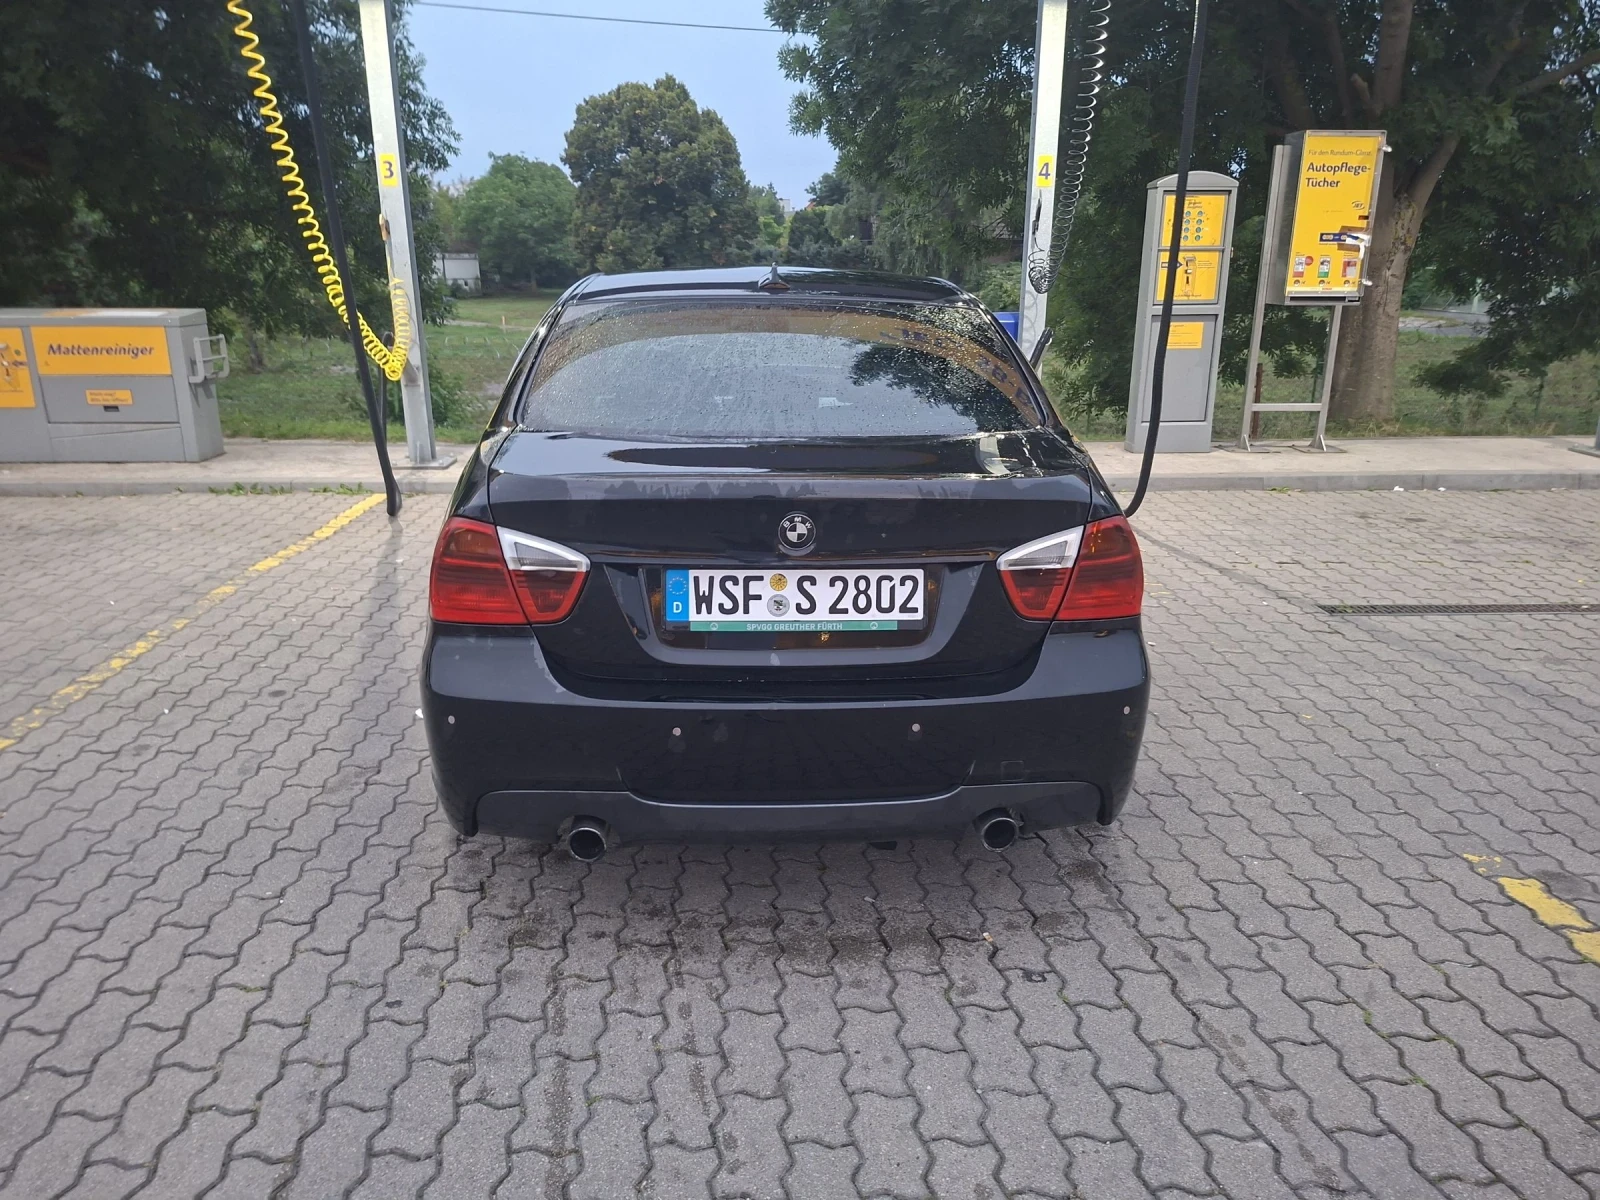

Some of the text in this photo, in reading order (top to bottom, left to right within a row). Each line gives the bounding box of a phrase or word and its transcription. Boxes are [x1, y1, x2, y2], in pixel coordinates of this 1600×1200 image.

[383, 160, 394, 179] 3
[1038, 162, 1051, 180] 4
[1306, 161, 1371, 176] Autopflege-
[1305, 176, 1340, 188] Tücher
[47, 343, 154, 360] Mattenreiniger
[782, 516, 812, 529] BMW
[693, 574, 919, 616] WSF S 2802
[673, 601, 683, 614] D
[746, 621, 843, 631] SPVGG GREUTHER FÜRTH
